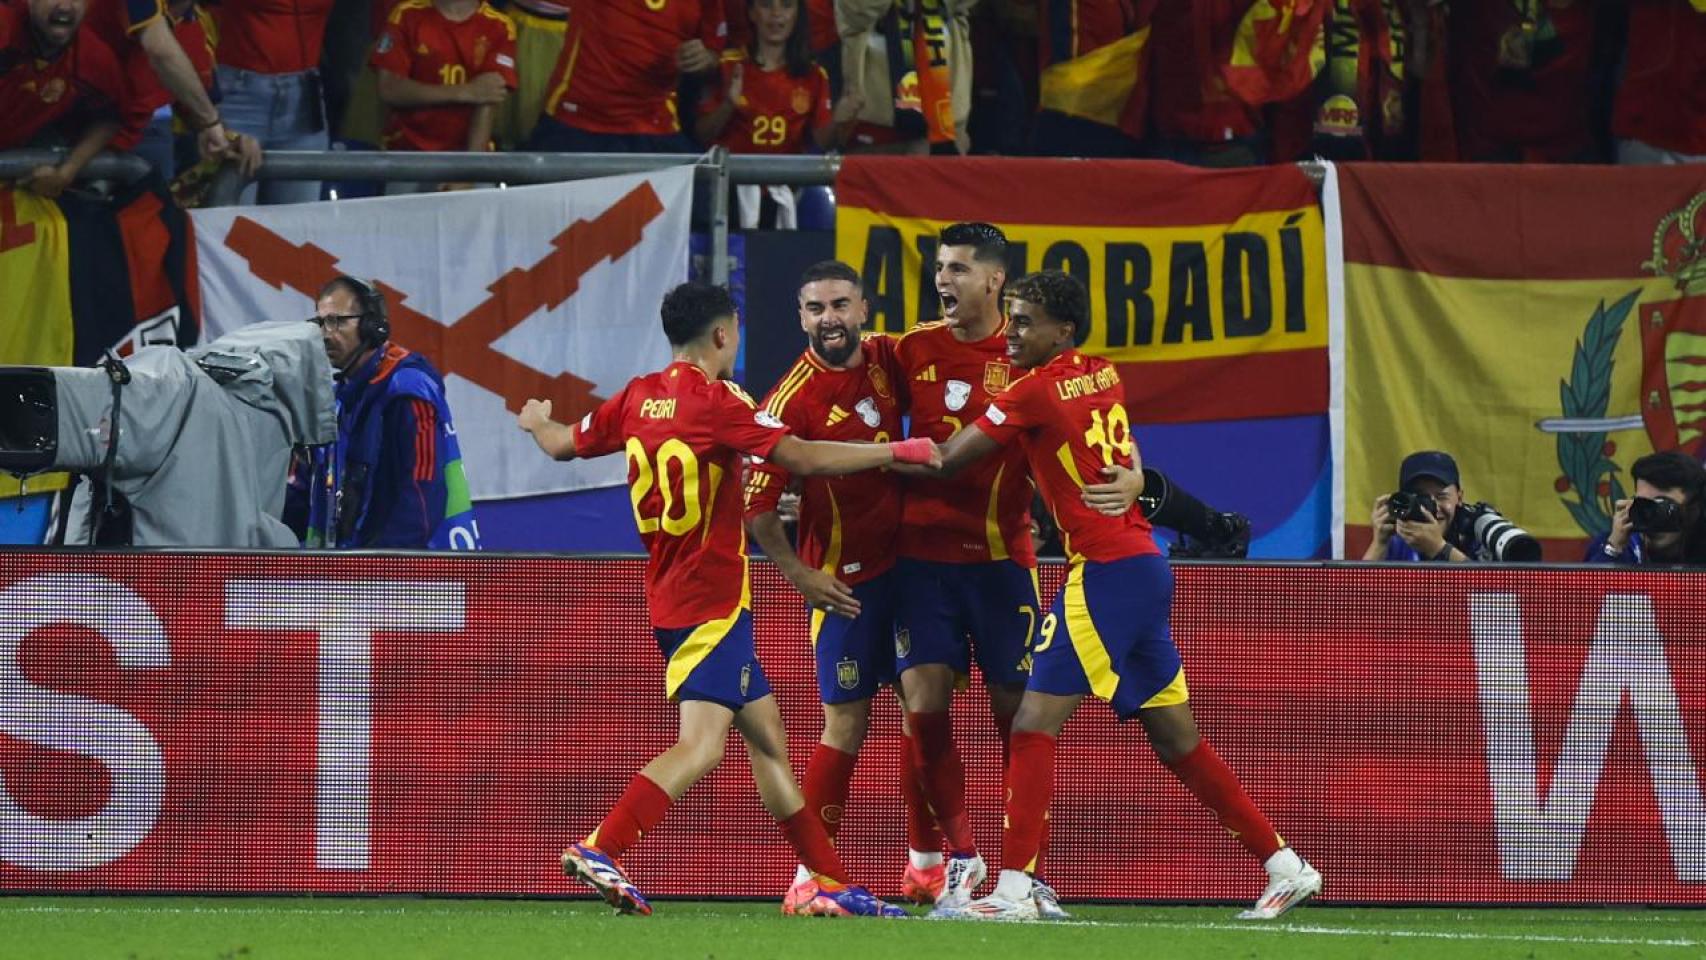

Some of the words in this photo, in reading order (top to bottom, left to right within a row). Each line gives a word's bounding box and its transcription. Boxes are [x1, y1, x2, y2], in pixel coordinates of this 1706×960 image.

[438, 63, 466, 86] 10
[752, 115, 786, 145] 29
[640, 398, 677, 419] PEDRI
[1085, 403, 1131, 466] 19
[625, 436, 702, 537] 20
[1018, 605, 1035, 648] 7
